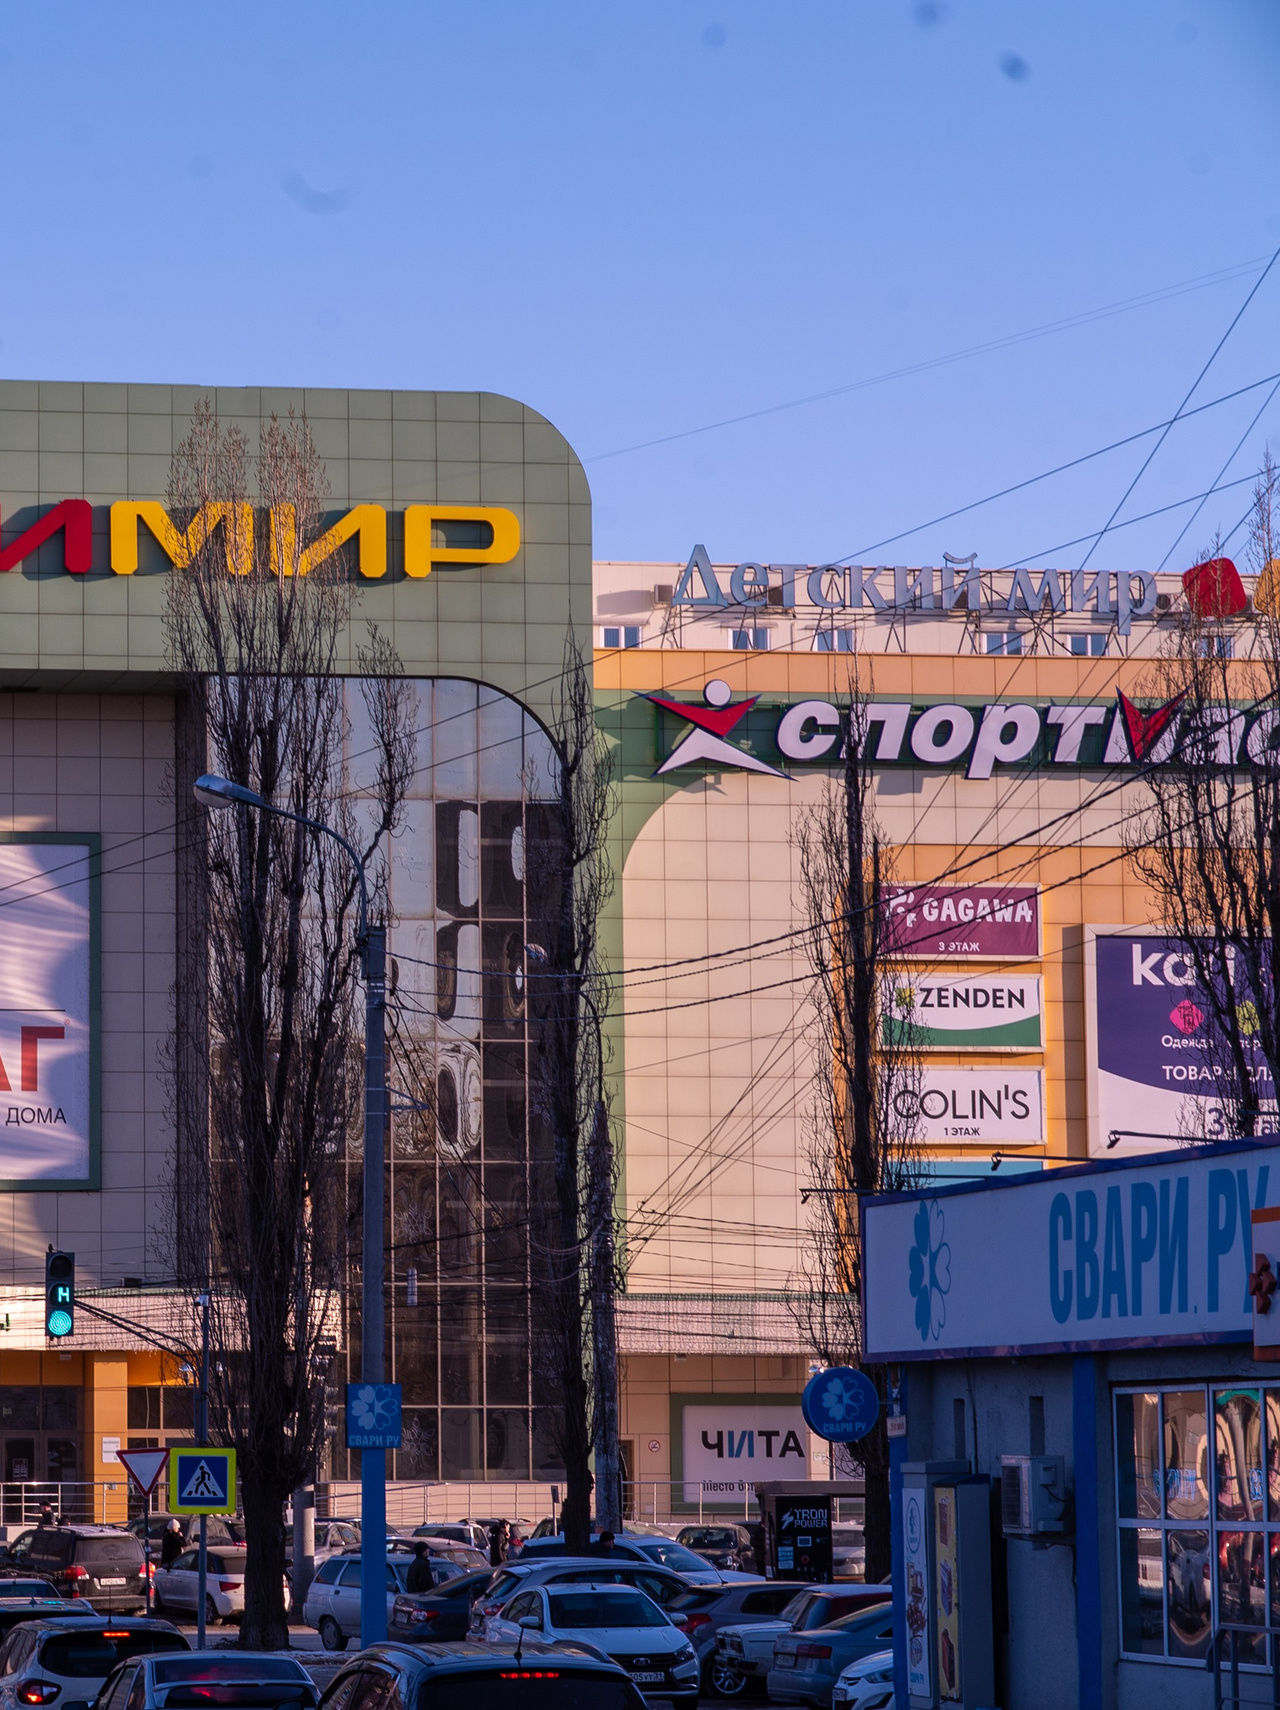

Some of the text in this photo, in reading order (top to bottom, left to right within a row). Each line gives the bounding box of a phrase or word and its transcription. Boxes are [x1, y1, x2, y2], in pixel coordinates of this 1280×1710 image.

[672, 544, 1158, 636] Детский мир
[923, 897, 1033, 923] GAGAWA
[938, 942, 980, 952] 3 ЭТАЖ
[919, 987, 1025, 1009] ZENDEN
[893, 1084, 1030, 1121] COLIN'S
[4, 1107, 67, 1126] ДОМА
[950, 1127, 981, 1137] ЭТАЖ
[823, 1422, 855, 1433] СВАРИ
[348, 1435, 400, 1446] СВАРИ РУ
[701, 1430, 805, 1458] ЧИТА
[794, 1508, 828, 1520] TRON
[794, 1519, 829, 1528] POWER
